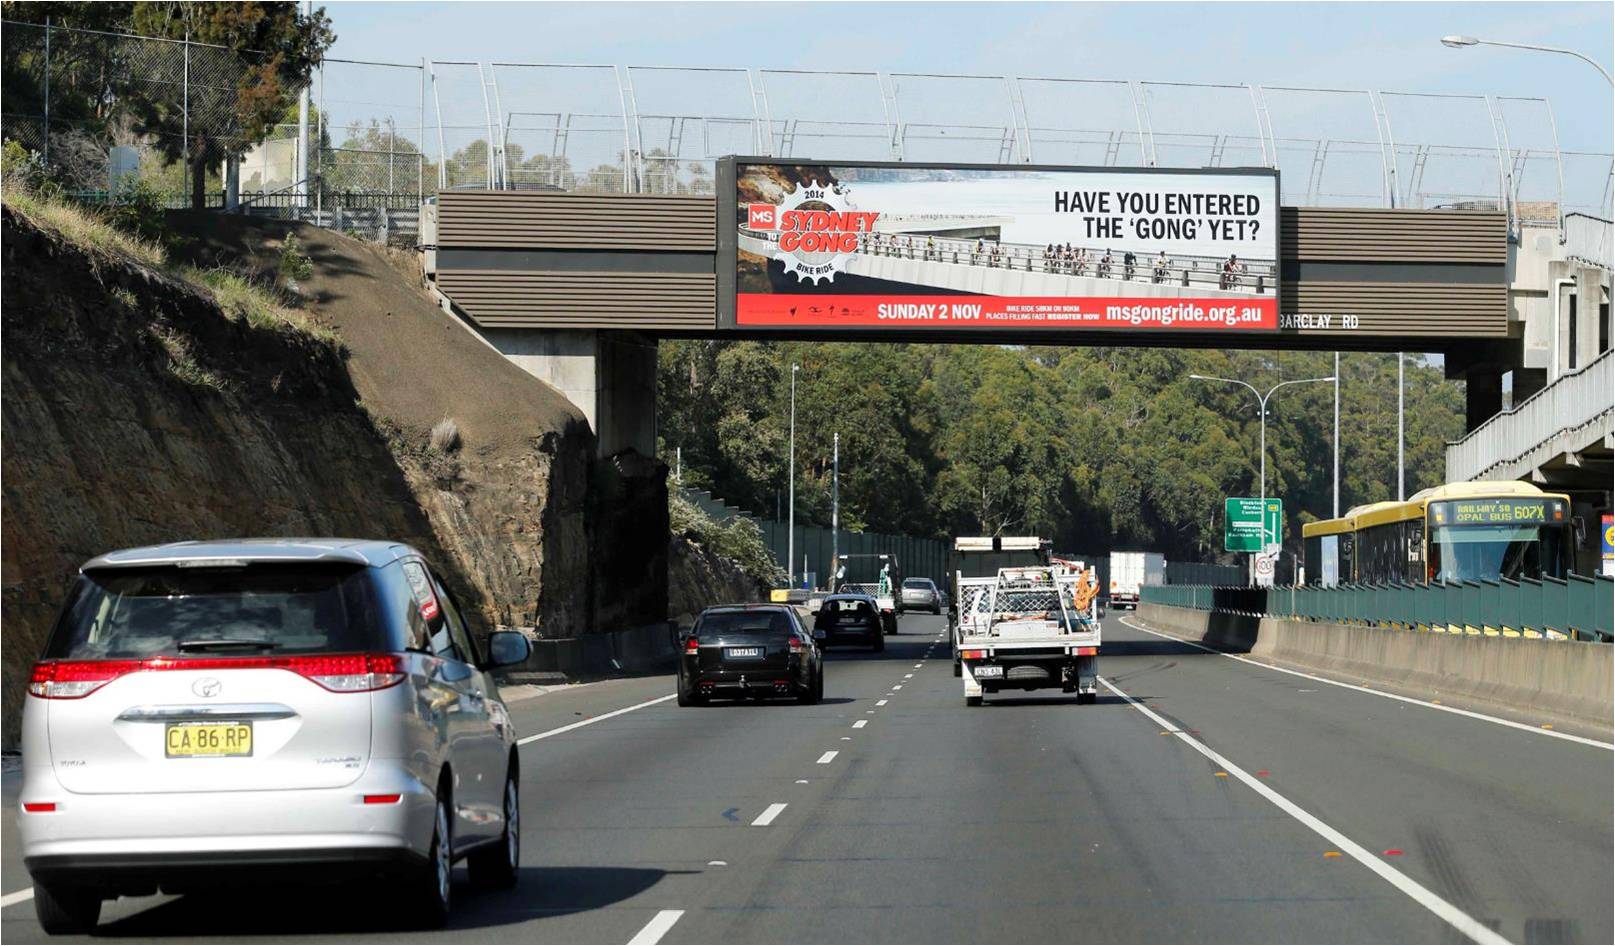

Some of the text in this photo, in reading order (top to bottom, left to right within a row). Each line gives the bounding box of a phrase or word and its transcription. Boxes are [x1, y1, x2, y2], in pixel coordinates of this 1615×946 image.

[804, 190, 825, 200] 2014
[1054, 191, 1260, 216] HAVE YOU ENTERED
[751, 210, 774, 223] MS
[779, 209, 880, 232] SYDNEY
[767, 232, 777, 241] TO
[1083, 217, 1260, 241] THE ‘GONG’ YET?
[779, 231, 858, 253] GONG
[796, 263, 834, 275] BIKE RIDE
[877, 303, 982, 320] SUNDAY 2 NOV
[985, 312, 1009, 320] PLACES
[1009, 312, 1031, 320] FILLING
[1032, 312, 1046, 320] FAST
[1083, 313, 1100, 321] NOW
[1106, 304, 1261, 325] msgongride.org.au
[1342, 315, 1358, 329] RD
[1456, 513, 1512, 521] OPAL BUS
[1457, 504, 1496, 512] RAILWAY
[1514, 505, 1544, 520] 607X
